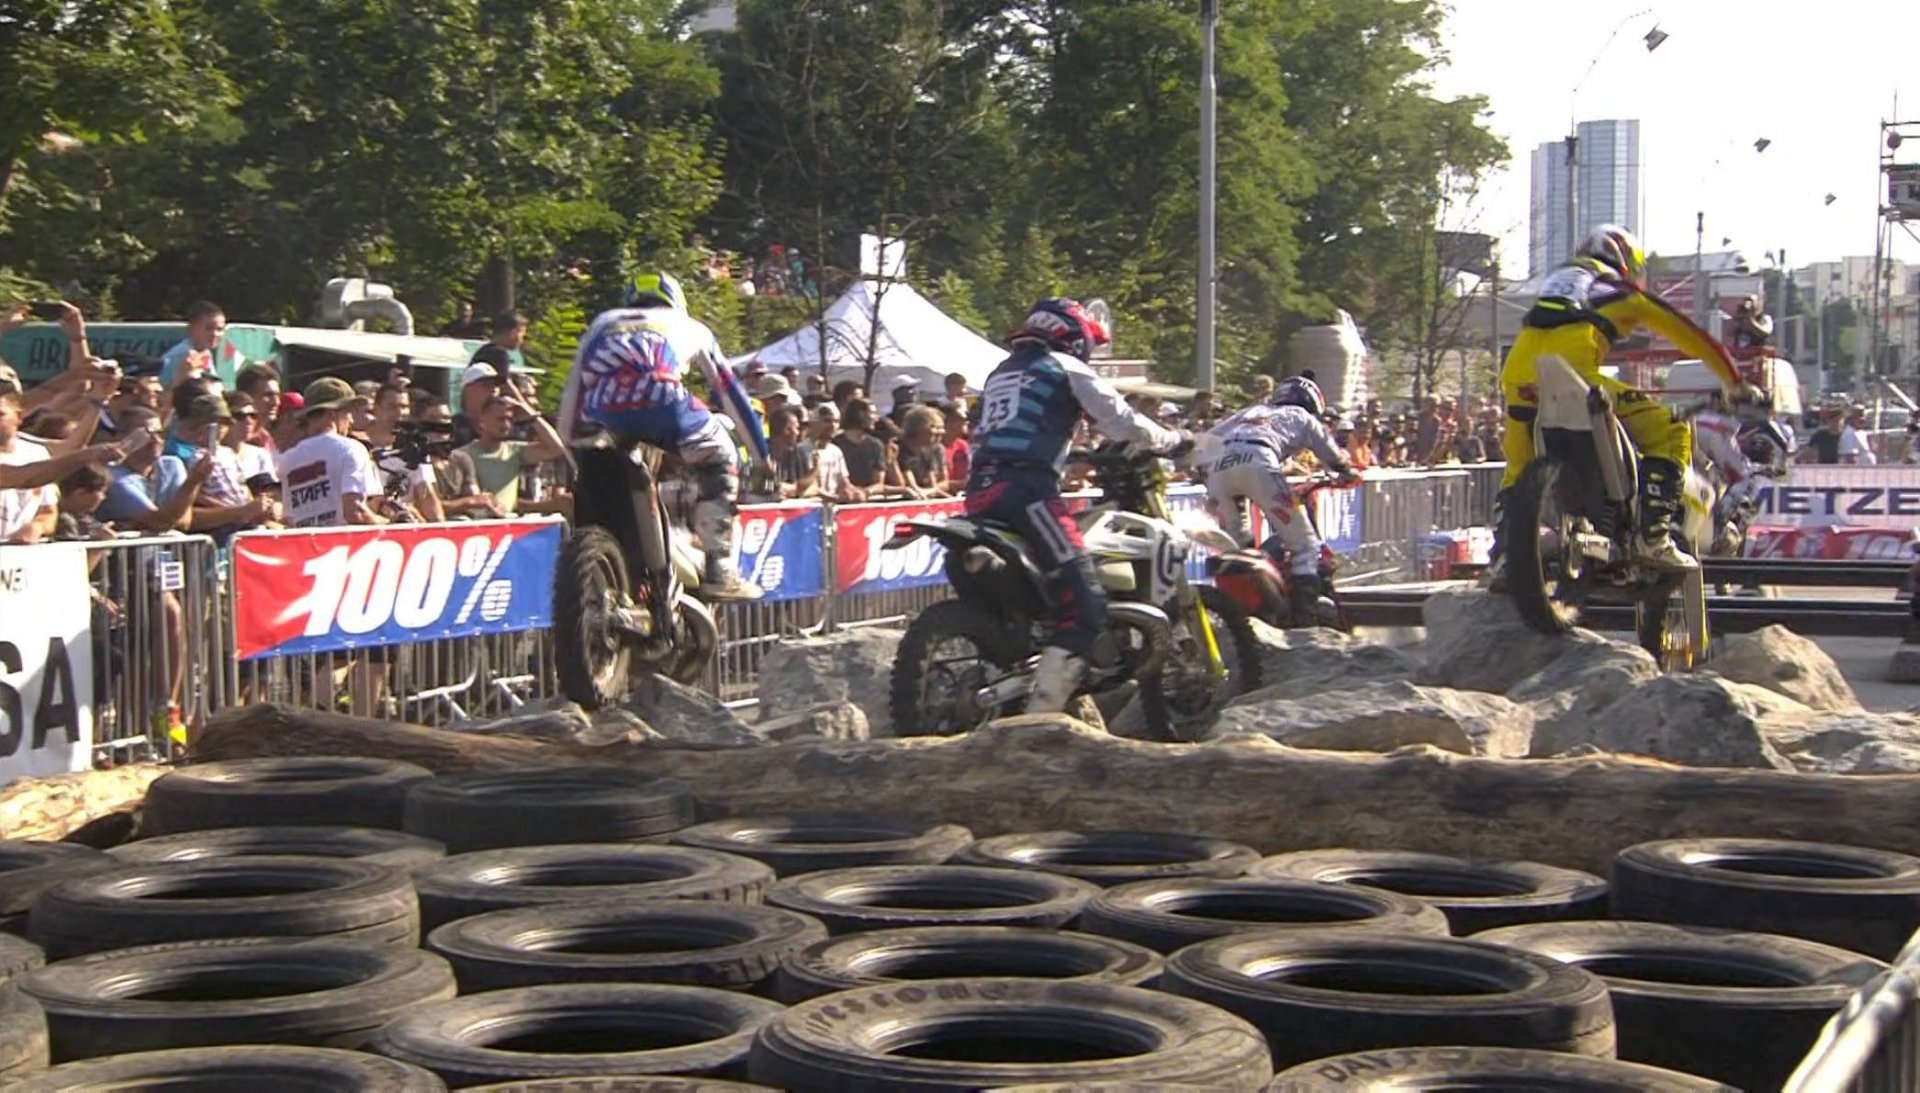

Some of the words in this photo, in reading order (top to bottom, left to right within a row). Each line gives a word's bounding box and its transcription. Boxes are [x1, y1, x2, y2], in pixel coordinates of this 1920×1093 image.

[987, 398, 1010, 421] 23
[291, 479, 331, 509] STAFF
[288, 533, 513, 637] 100%
